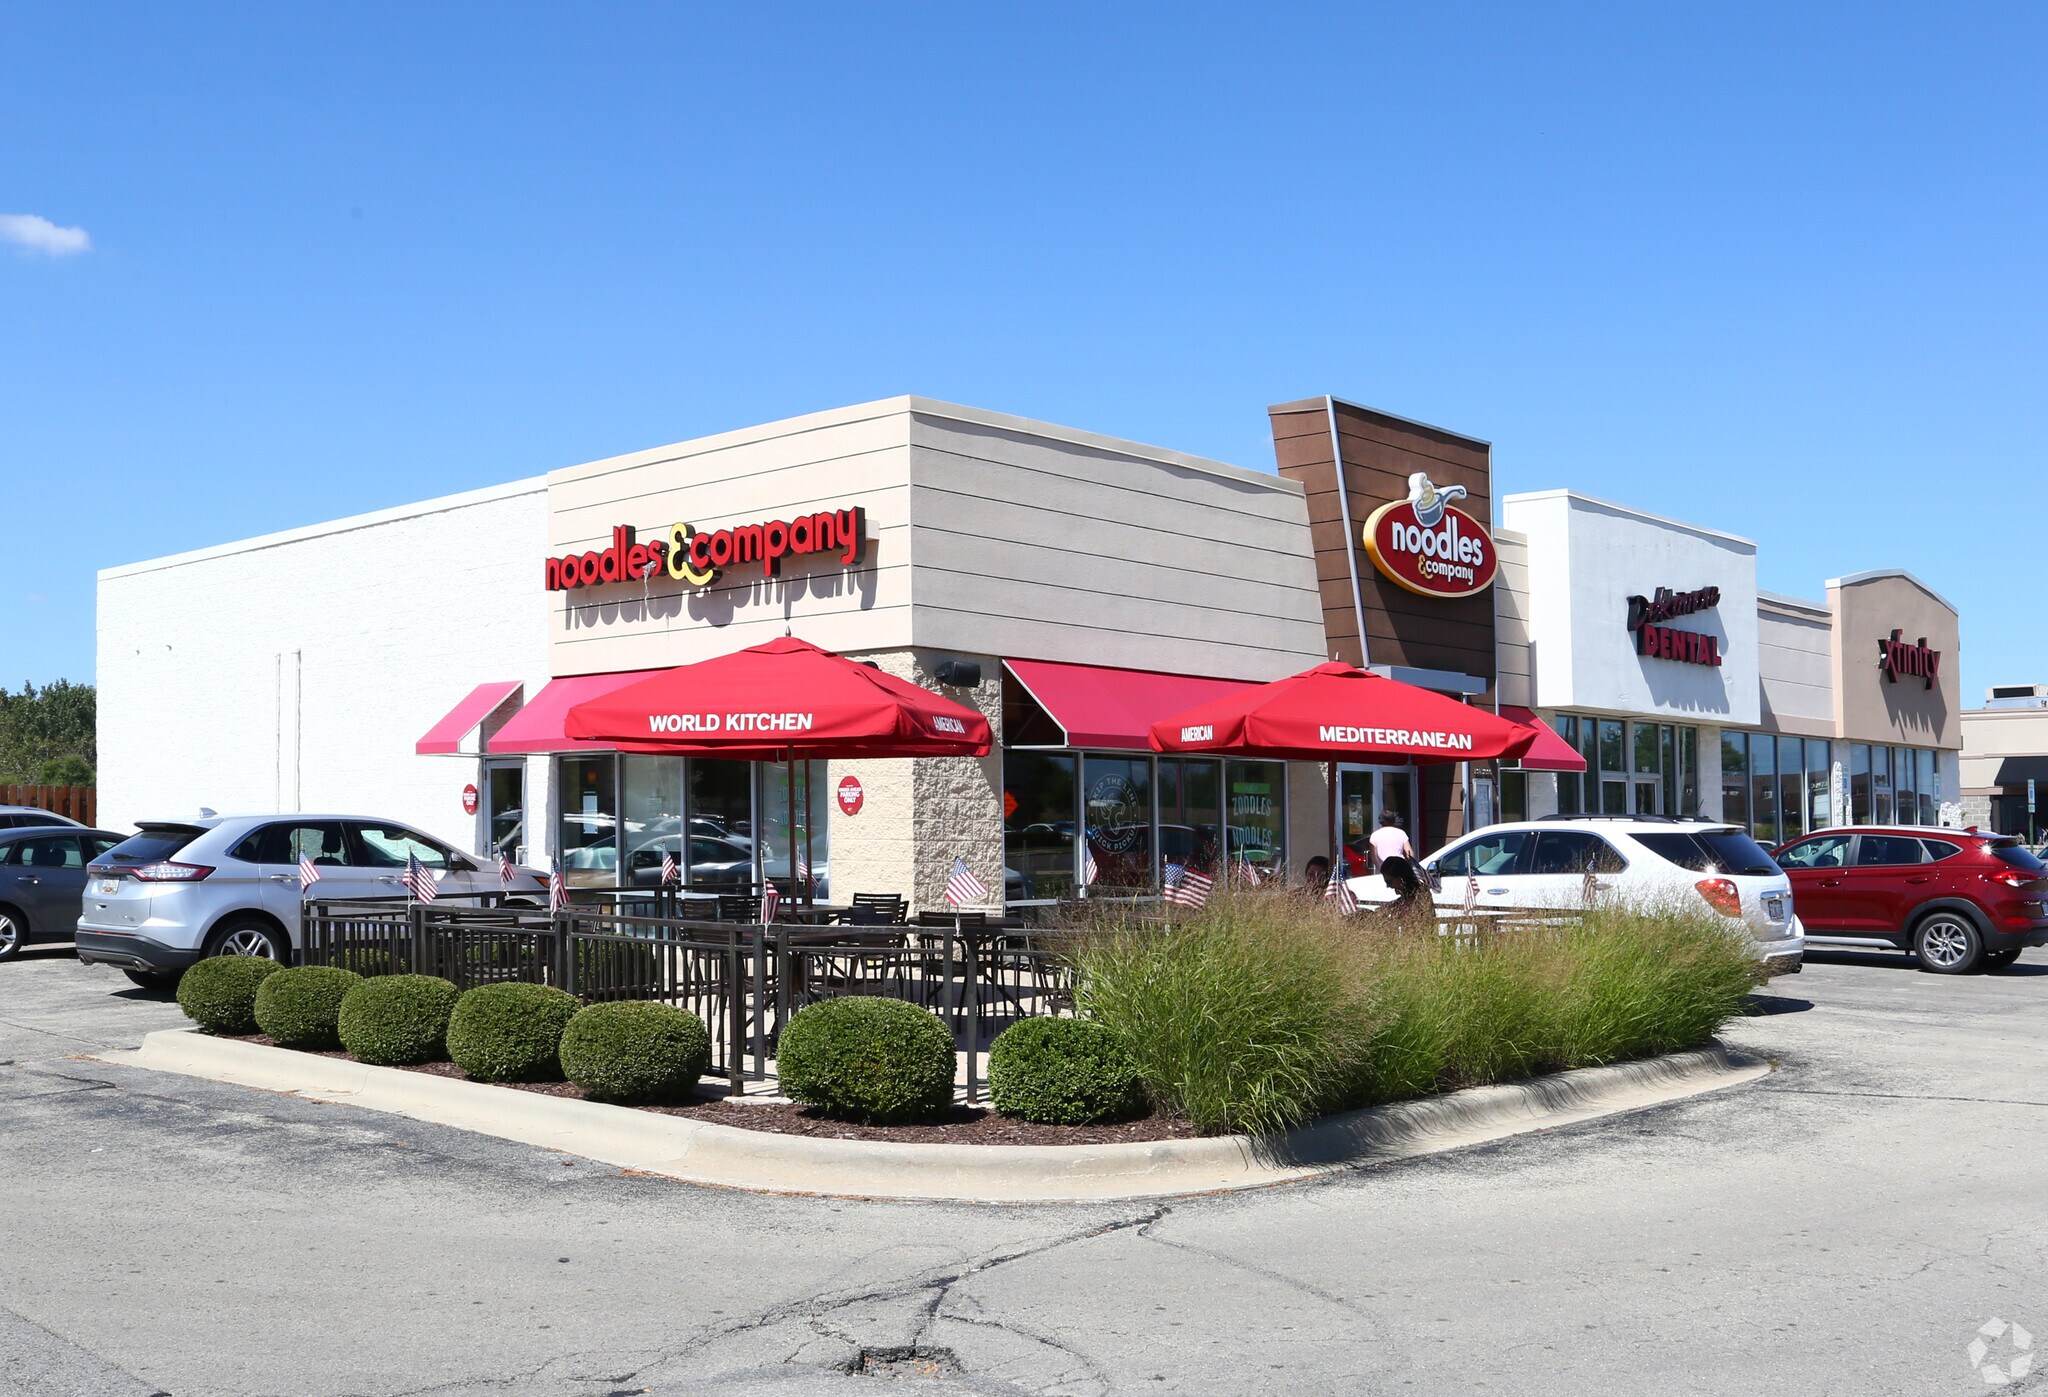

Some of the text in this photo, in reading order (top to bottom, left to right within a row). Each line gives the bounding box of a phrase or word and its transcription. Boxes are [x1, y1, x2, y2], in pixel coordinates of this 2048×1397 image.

[1391, 513, 1483, 567] noodles
[545, 523, 666, 591] noodles
[1638, 622, 1722, 667] DENTAL
[648, 712, 813, 733] WORLD KITCHEN
[932, 715, 966, 735] AMERICAN
[1181, 724, 1214, 743] AMERICAN
[1319, 725, 1472, 750] MEDITERRANEAN
[1105, 777, 1122, 786] THE
[1122, 783, 1137, 808] LINE
[1231, 795, 1272, 817] ZOODLES
[1091, 823, 1136, 851] QUICK PICKUP
[1232, 825, 1273, 849] NOODLES
